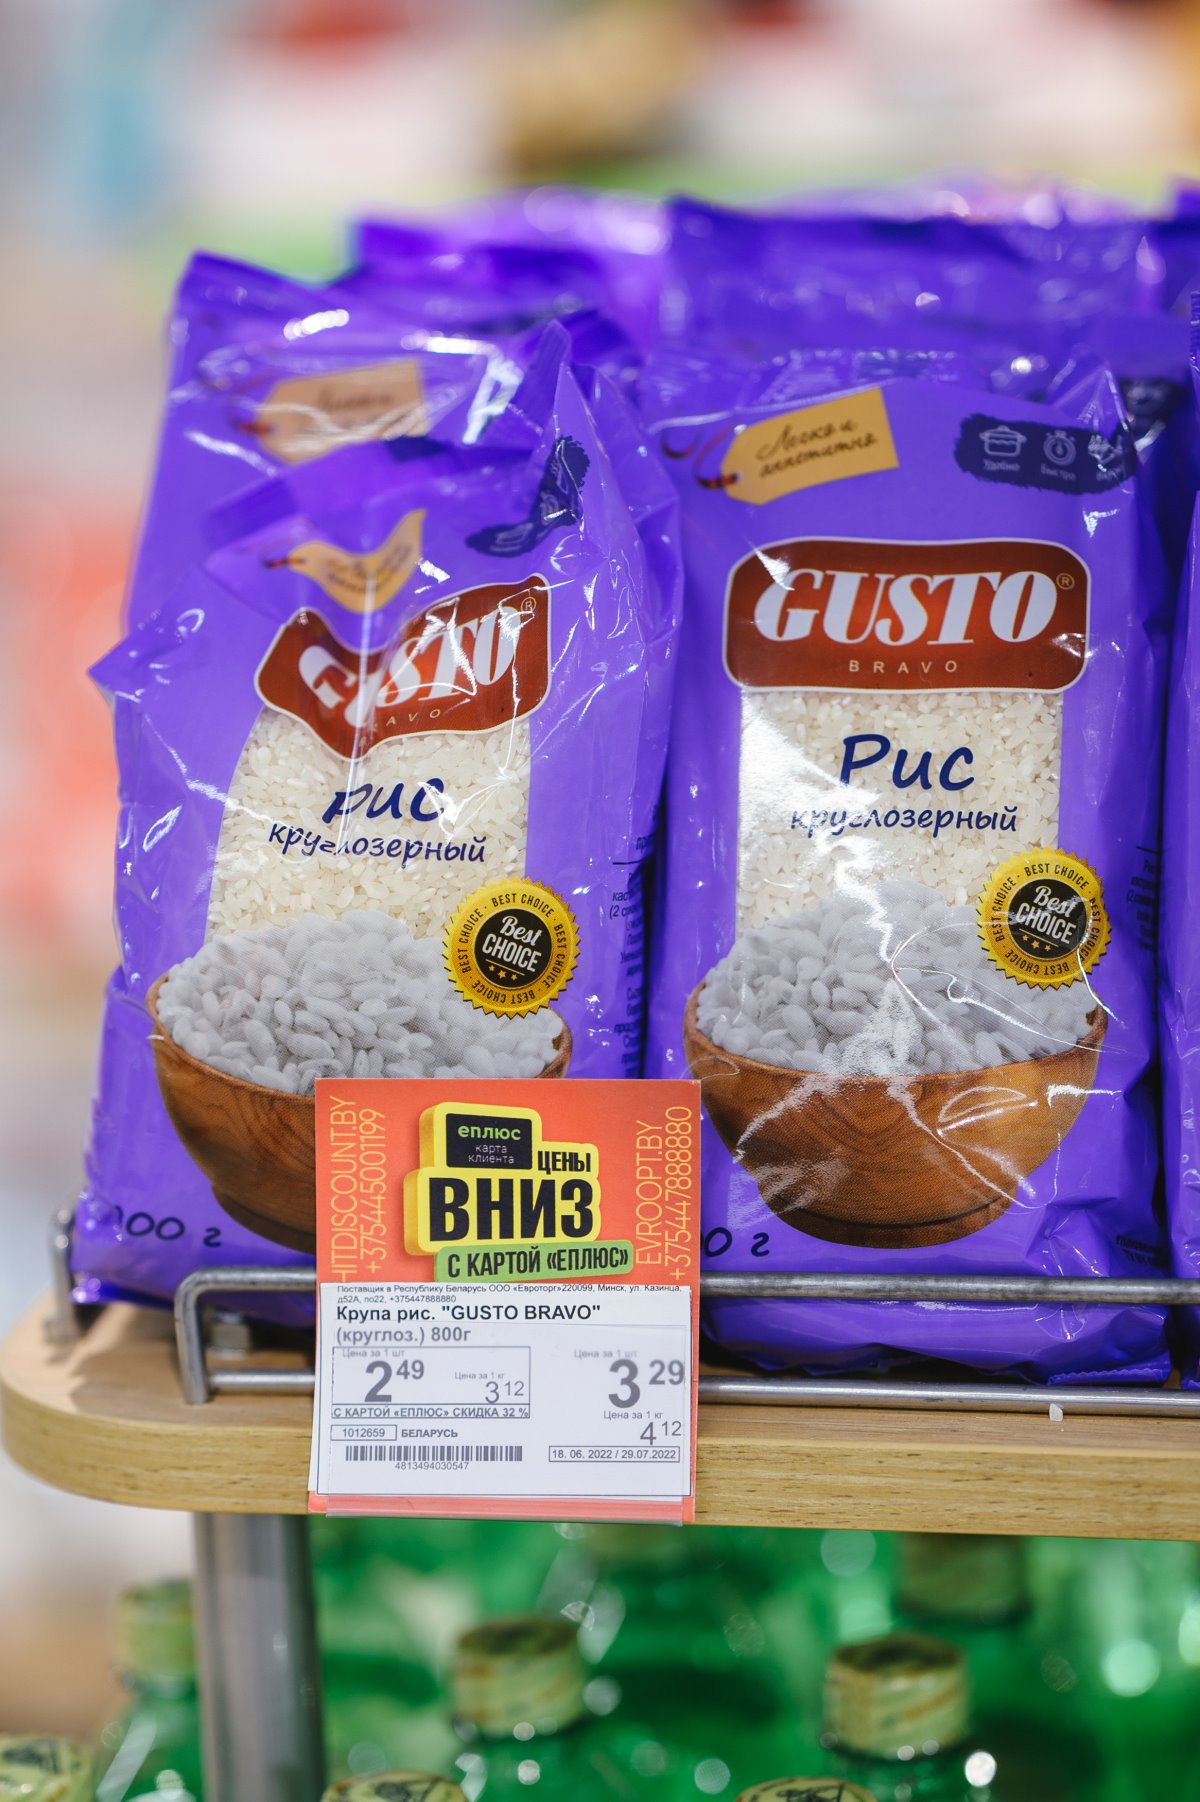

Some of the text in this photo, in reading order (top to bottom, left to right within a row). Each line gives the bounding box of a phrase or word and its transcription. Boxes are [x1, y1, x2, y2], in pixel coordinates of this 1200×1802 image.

[753, 567, 1059, 646] GUSTO
[849, 658, 958, 674] BRAVO
[839, 733, 975, 791] Рис
[790, 804, 1019, 838] круглозерный
[269, 823, 487, 869] круглозерный
[1024, 863, 1089, 890] BEST CHOICE
[491, 893, 555, 918] BEST CHOICE
[991, 876, 1017, 942] BEST CHOICE
[1033, 885, 1079, 918] Best
[500, 915, 543, 946] Best
[1015, 902, 1077, 945] CHOICE
[457, 908, 484, 974] BEST CHOICE
[482, 933, 542, 972] CHOICE
[543, 924, 567, 989] BEST CHOICE
[1005, 949, 1070, 975] BEST CHOICE
[471, 980, 536, 1004] BEST CHOICE
[458, 1125, 521, 1141] еплюс
[468, 1155, 515, 1164] клиента
[475, 1144, 508, 1154] карта
[538, 1151, 591, 1174] ЦЕНЫ
[330, 1096, 358, 1282] HITDISCOUNT.BY
[359, 1108, 387, 1273] +375445001199
[636, 1120, 662, 1265] EVROOPT.BY
[665, 1106, 692, 1280] +375447888880
[429, 1177, 593, 1242] ВНИЗ
[448, 1246, 629, 1278] С КАРТОЙ «ЕПЛЮС»
[337, 1285, 384, 1294] Поставщик
[394, 1284, 443, 1294] Республику
[446, 1284, 486, 1293] Беларусь
[489, 1284, 511, 1292] ООО
[598, 1285, 627, 1294] Минск,
[644, 1284, 682, 1294] Казинца,
[337, 1295, 362, 1304] д52А,
[390, 1294, 457, 1304] +375447888880
[337, 1304, 601, 1324] Крупа рис. "GUSTO BRAVO"
[336, 1326, 471, 1346] (круглоз.) 800г
[342, 1349, 367, 1358] Цена
[574, 1349, 600, 1358] Цена
[624, 1350, 638, 1358] шт
[364, 1359, 425, 1402] 2 49
[454, 1372, 476, 1380] Цена
[608, 1359, 685, 1409] 3 29
[485, 1380, 525, 1404] 3 12
[333, 1405, 529, 1418] С КАРТОЙ «ЕПЛЮС» СКИДКА 32 %
[603, 1411, 629, 1420] Цена
[342, 1428, 458, 1438] 1012659 БЕЛАРУСЬ
[640, 1421, 682, 1445] 4 12
[395, 1461, 469, 1470] 4813494030547
[588, 1450, 613, 1459] 2022
